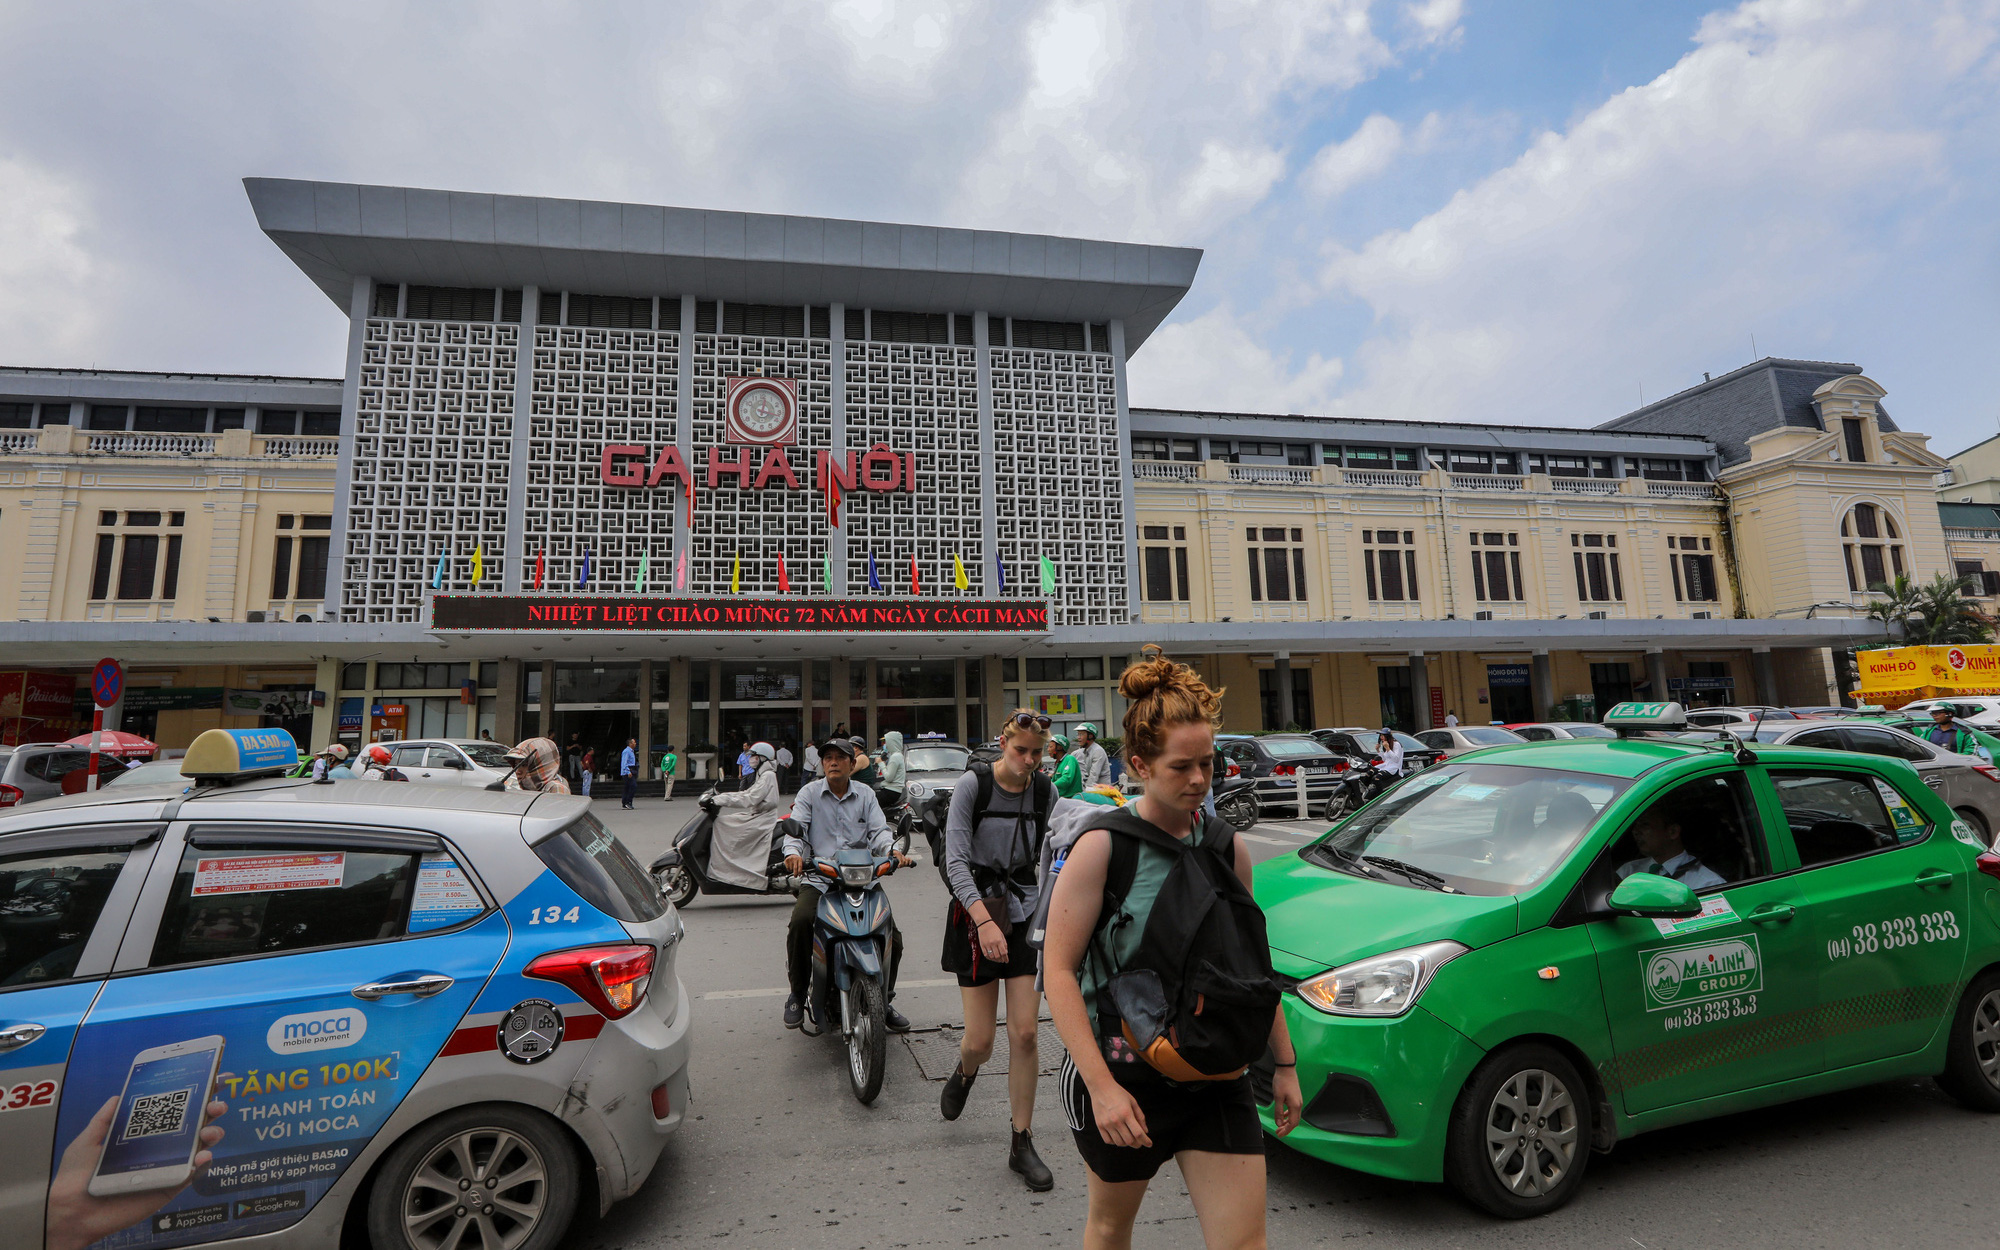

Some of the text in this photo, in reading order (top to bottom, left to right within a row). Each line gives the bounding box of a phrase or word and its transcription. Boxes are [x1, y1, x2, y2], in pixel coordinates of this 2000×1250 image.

[600, 441, 915, 494] GA HÀ NỘI
[603, 603, 652, 625] LIỆT
[725, 603, 790, 623] MỪNG
[795, 608, 815, 623] 72
[821, 604, 867, 623] NĂM
[873, 604, 930, 623] NGÀY
[1869, 659, 1916, 674] KINH ĐÔ
[1967, 657, 1997, 670] KINH
[341, 717, 361, 725] ATM
[529, 905, 579, 925] 134
[1827, 910, 1960, 961] (04) 38 333 333
[1699, 973, 1747, 992] GROUP
[1664, 1016, 1682, 1031] (04)
[1704, 1000, 1730, 1023] 333
[284, 1016, 351, 1040] moca
[283, 1033, 350, 1047] mobile payment
[224, 1057, 392, 1102] TẶNG 100K
[0, 1081, 56, 1110] .32
[239, 1088, 376, 1122] THANH TOÁN
[255, 1114, 360, 1141] VỚI MOCA
[207, 1148, 349, 1179] Nhập mã giới thiệu BASAO
[220, 1161, 336, 1187] khi đăng ký app Moca
[176, 1209, 203, 1219] Download
[254, 1199, 300, 1213] Google Play
[175, 1212, 223, 1229] App Store
